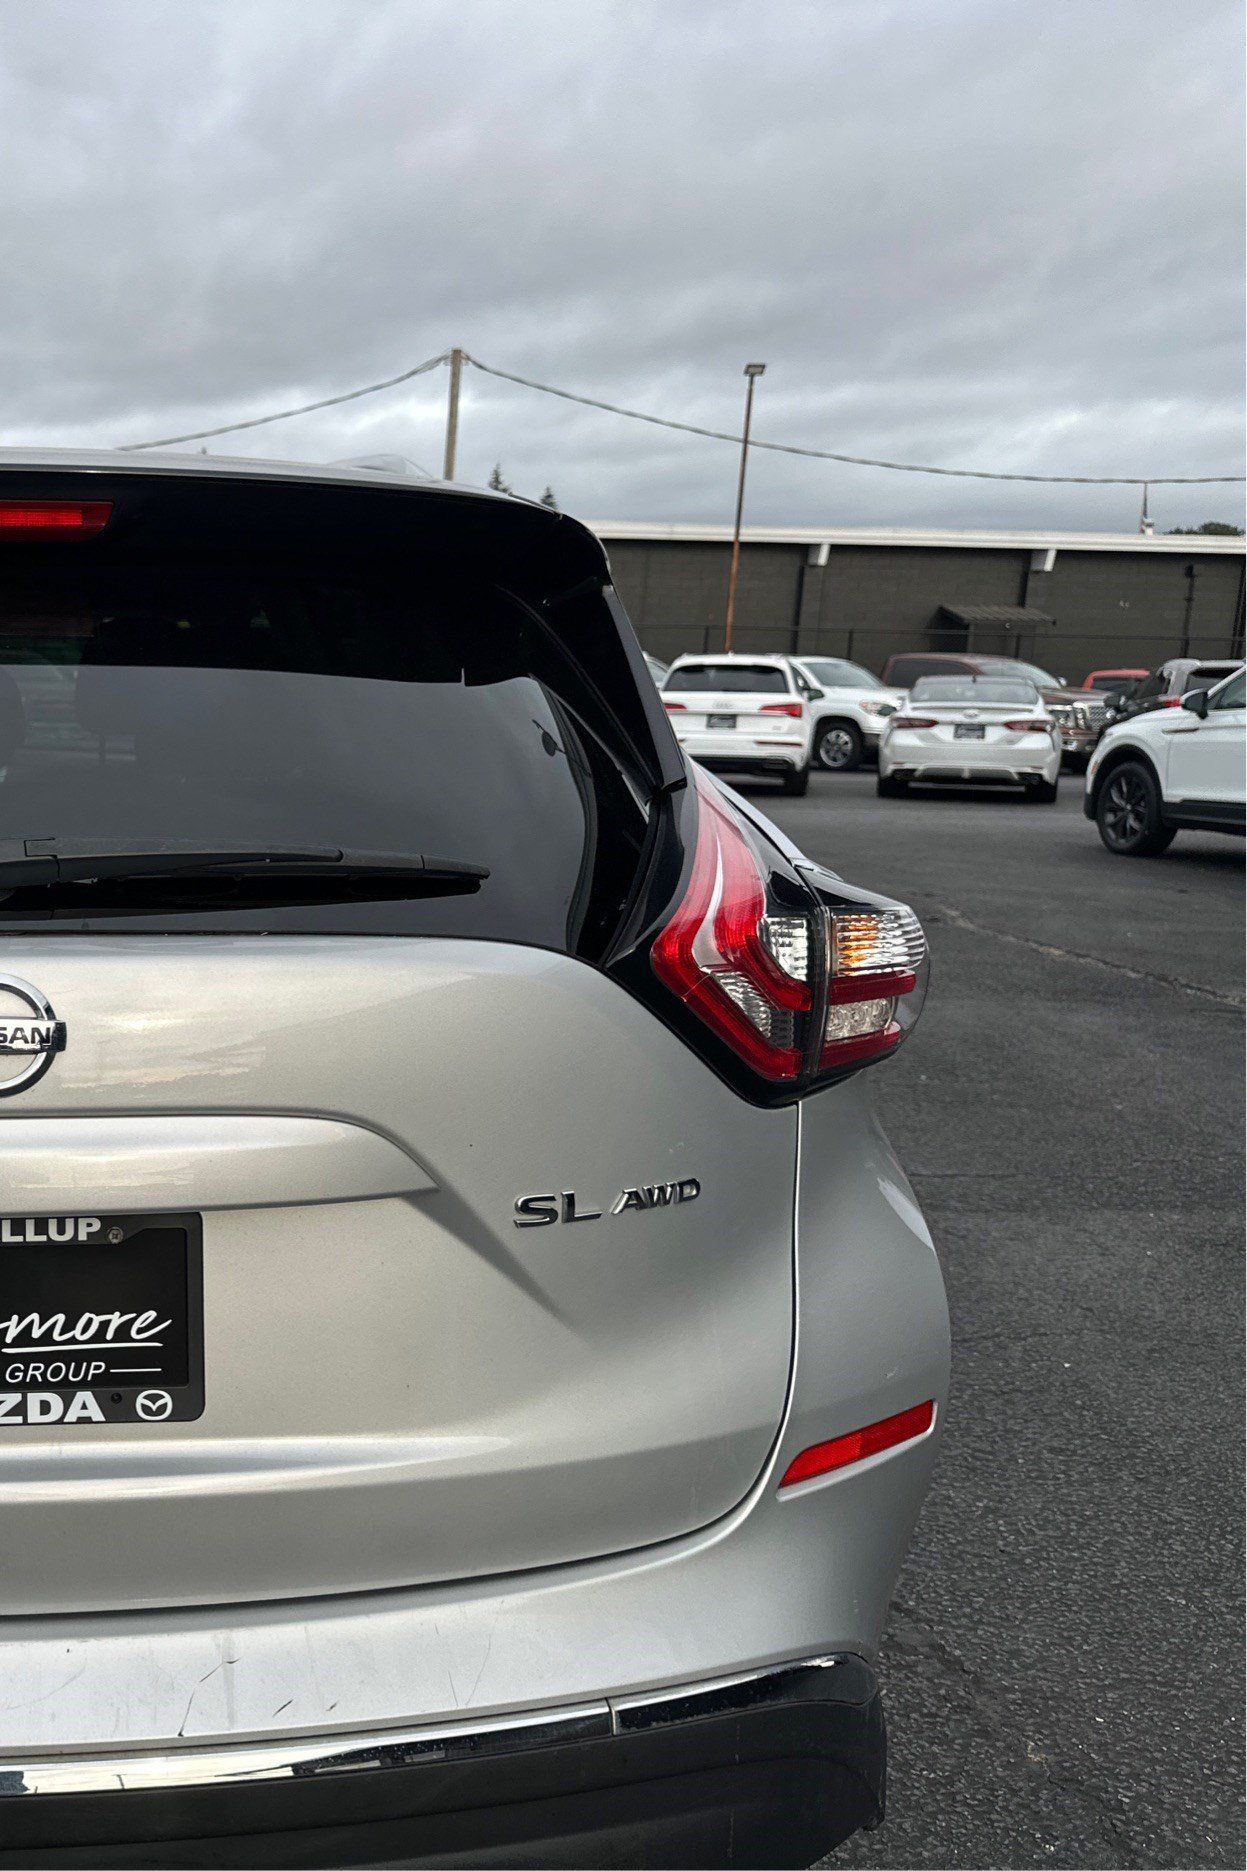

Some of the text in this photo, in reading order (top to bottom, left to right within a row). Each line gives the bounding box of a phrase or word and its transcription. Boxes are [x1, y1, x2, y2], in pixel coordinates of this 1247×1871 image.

[513, 1177, 701, 1228] SL AWD
[4, 1361, 106, 1383] GROUP
